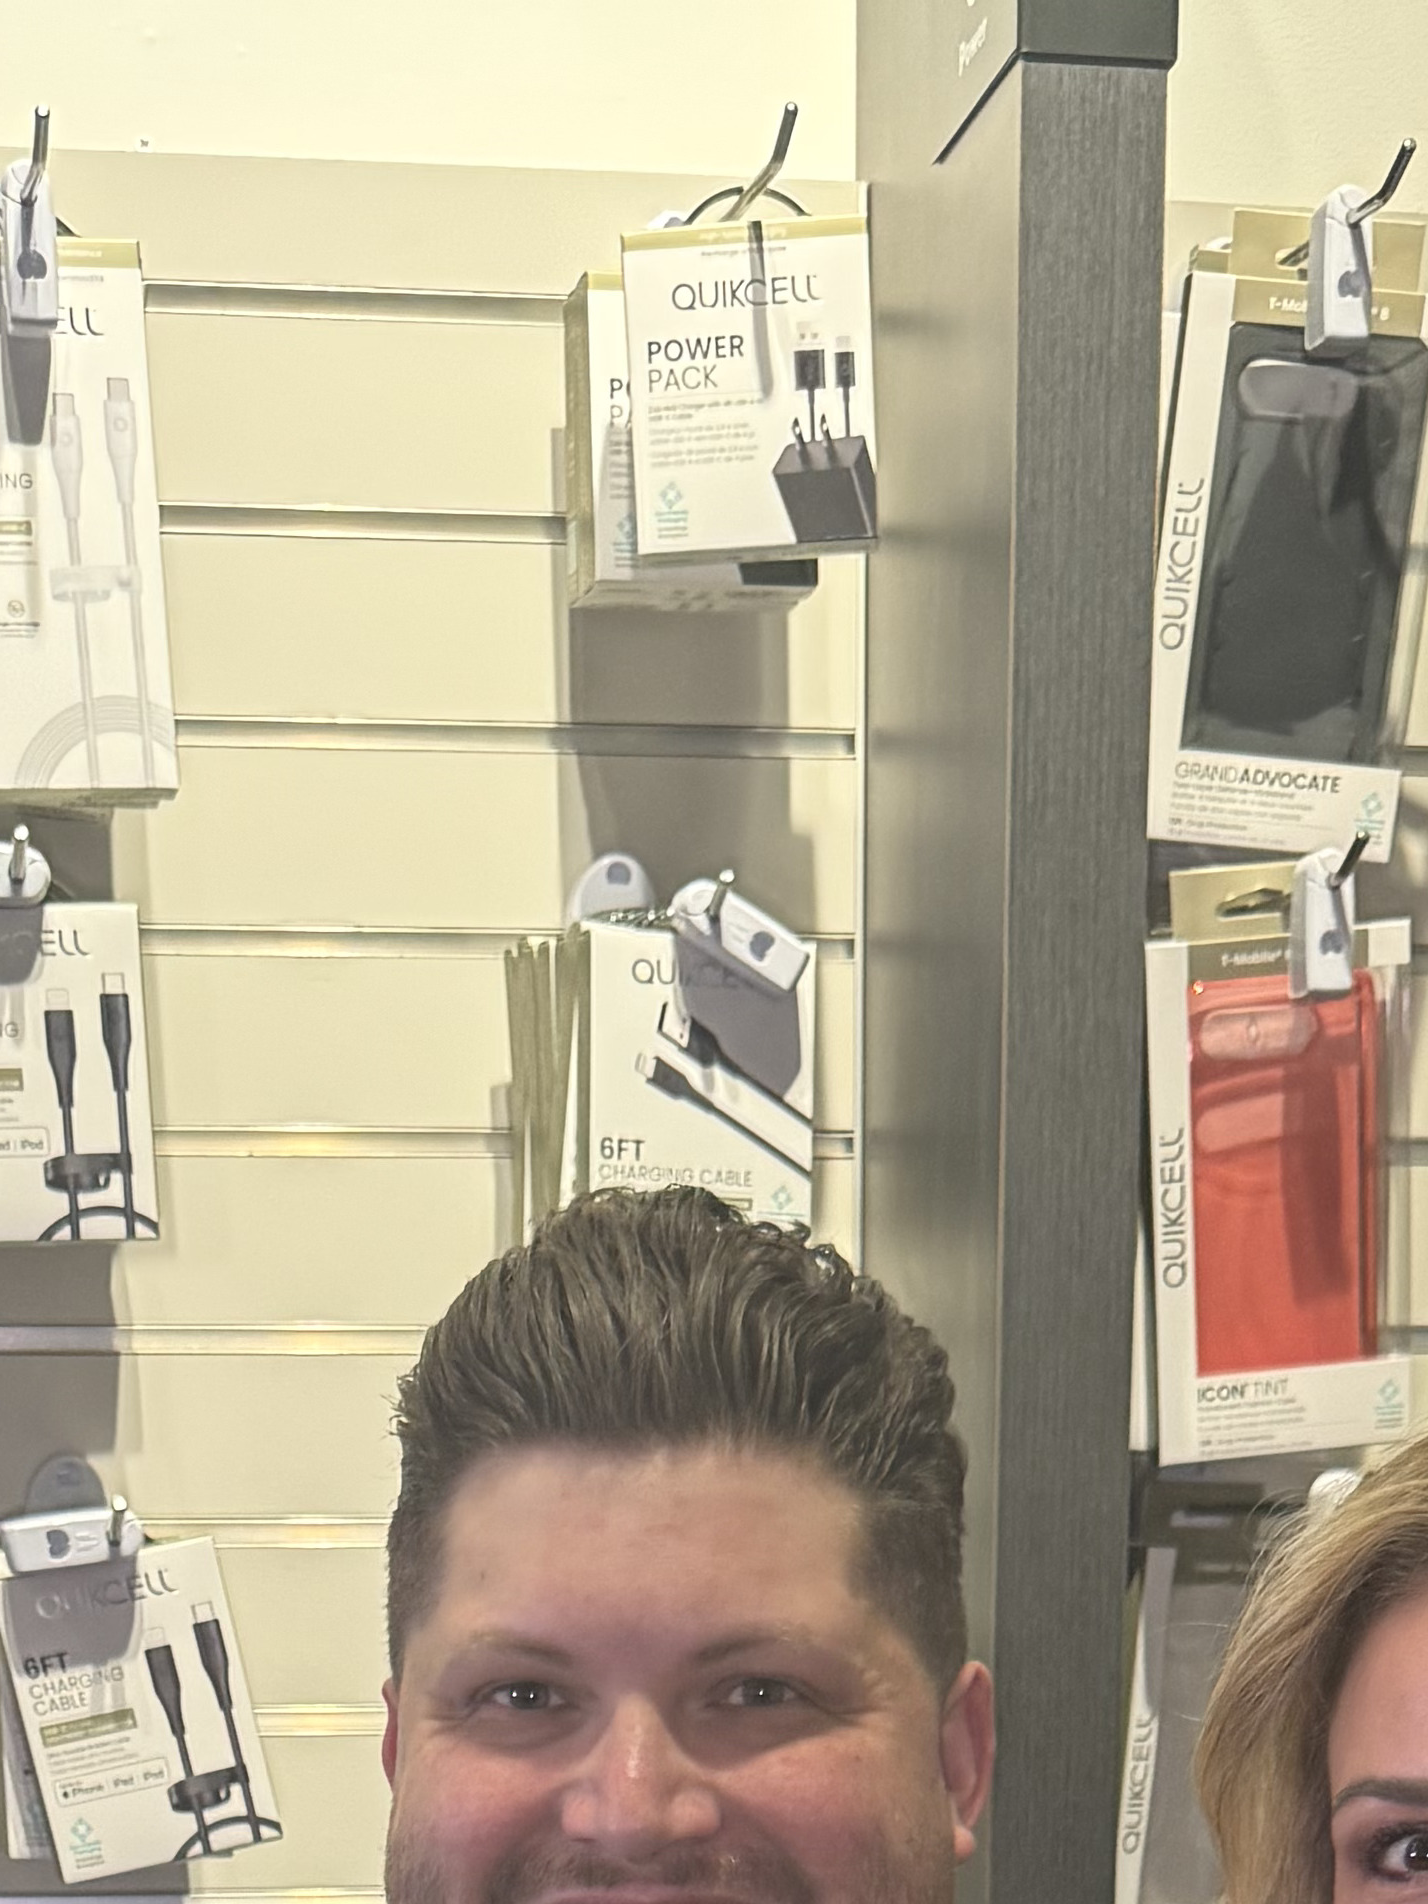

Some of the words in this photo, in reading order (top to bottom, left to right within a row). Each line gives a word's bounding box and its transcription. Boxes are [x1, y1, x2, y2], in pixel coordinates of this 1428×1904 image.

[672, 275, 821, 311] QUIKCELL
[648, 335, 744, 364] POWER
[648, 364, 717, 393] PACK
[1158, 477, 1204, 651] QUIKCELL
[1174, 761, 1341, 794] GRANDADVOCATE
[20, 1138, 44, 1152] iPod
[599, 1137, 646, 1161] 6FT
[598, 1165, 694, 1184] CHARGING
[699, 1169, 753, 1187] CABLE
[1162, 1127, 1185, 1289] QUIKCELL
[24, 1651, 69, 1680] 6FT
[28, 1665, 125, 1700] CHARGING
[32, 1691, 89, 1716] CABLE
